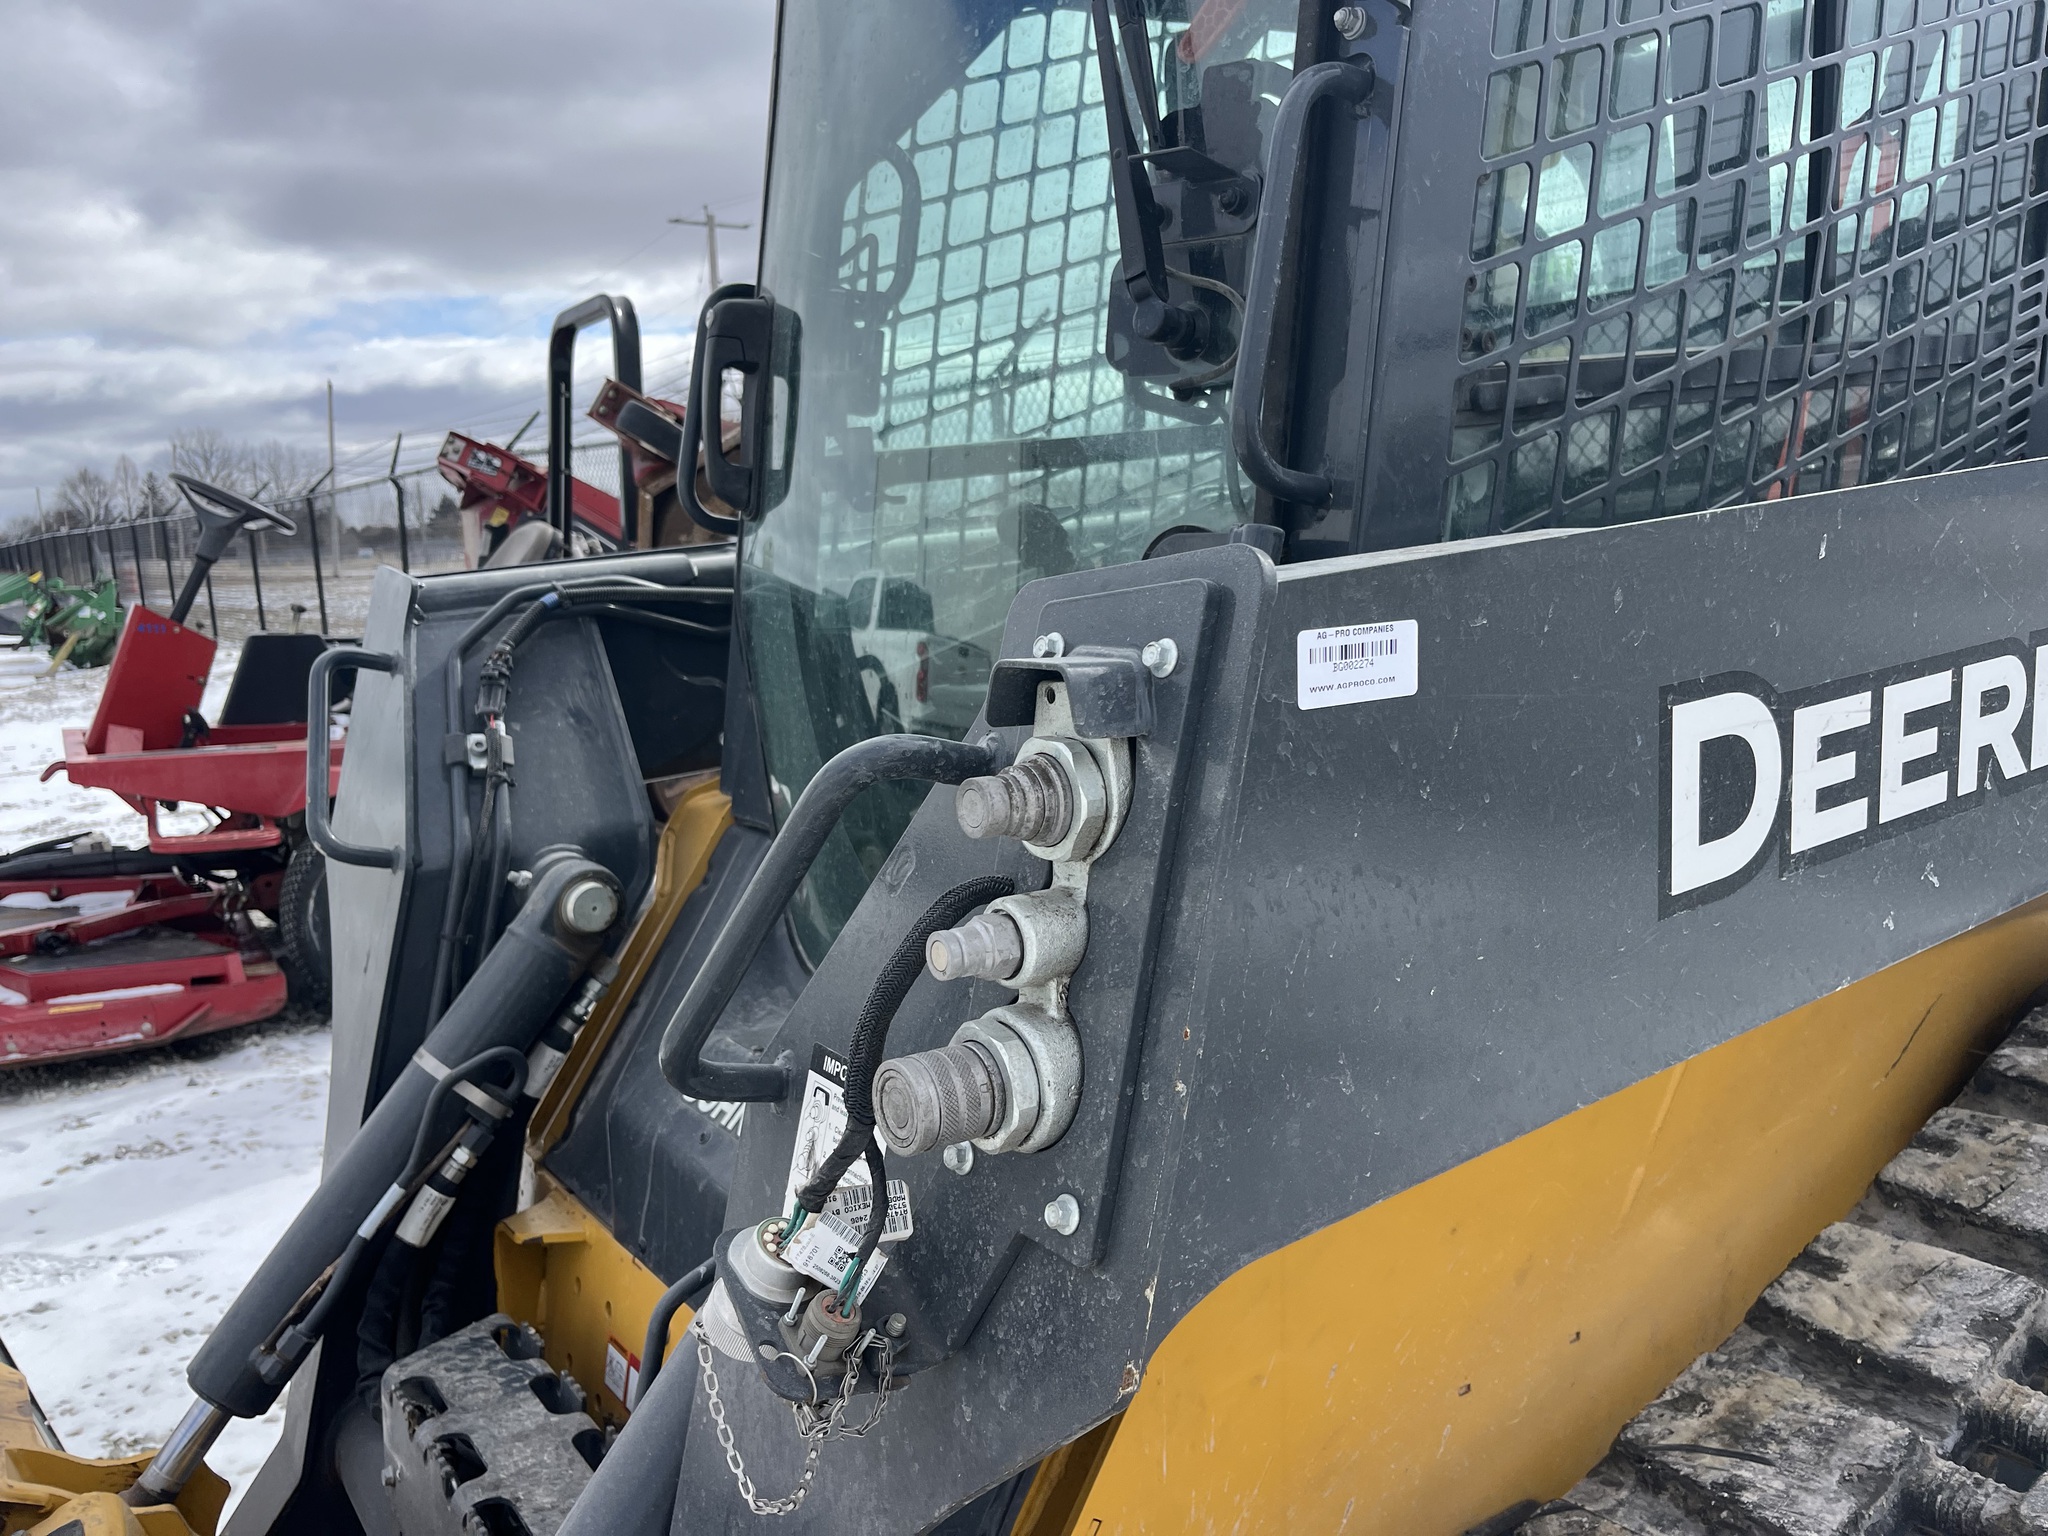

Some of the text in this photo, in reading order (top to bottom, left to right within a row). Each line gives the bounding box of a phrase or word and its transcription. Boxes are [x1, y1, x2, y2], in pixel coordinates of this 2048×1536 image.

[1352, 624, 1394, 636] COMPANIES
[1333, 658, 1375, 673] BG002274
[1309, 676, 1396, 693] WWW.AGPROCO.COM
[1671, 643, 2048, 896] DEER
[844, 1202, 871, 1213] MEXICO
